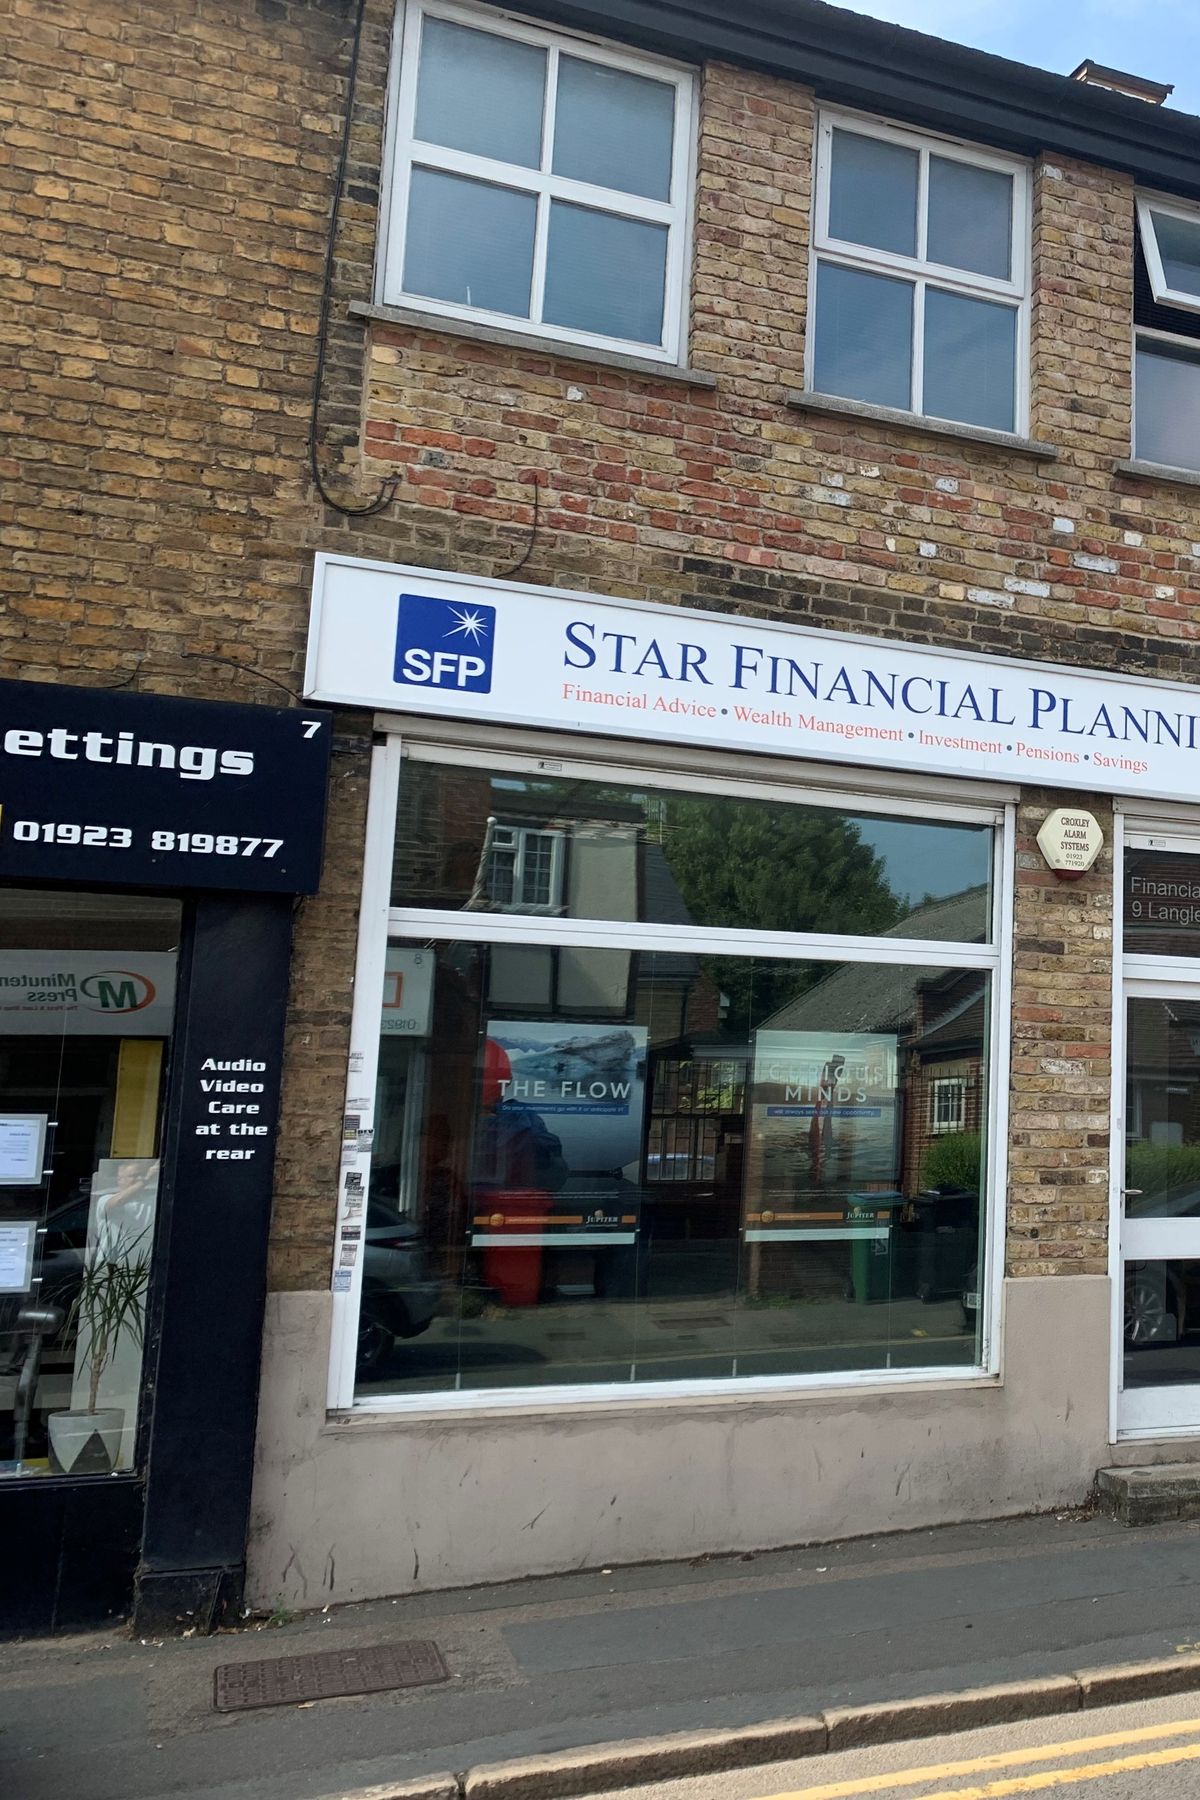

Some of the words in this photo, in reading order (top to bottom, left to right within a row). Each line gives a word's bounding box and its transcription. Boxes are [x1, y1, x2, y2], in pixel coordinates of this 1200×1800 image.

[402, 648, 486, 688] SFP
[564, 621, 713, 686] STAR
[729, 644, 1016, 727] FINANCIAL
[300, 721, 322, 739] 7
[562, 683, 647, 710] Financial
[652, 696, 717, 719] Advice
[734, 705, 792, 729] Wealth
[798, 713, 903, 745] Management
[918, 730, 1002, 754] Investment
[1016, 741, 1080, 764] Pensions
[1093, 752, 1149, 775] Savings
[3, 728, 255, 781] ettings
[1061, 817, 1090, 827] CROXLEY
[13, 821, 133, 849] 01923
[151, 831, 284, 858] 819877
[1064, 830, 1086, 839] ALARM
[1061, 841, 1089, 851] SYSTEMS
[1132, 901, 1143, 917] 9
[200, 1057, 267, 1073] Audio
[200, 1079, 264, 1094] Video
[498, 1080, 546, 1097] THE
[561, 1082, 631, 1098] FLOW
[786, 1086, 867, 1102] MINDS
[208, 1101, 260, 1115] Care
[195, 1122, 220, 1136] at
[230, 1122, 268, 1136] the
[206, 1147, 255, 1160] rear
